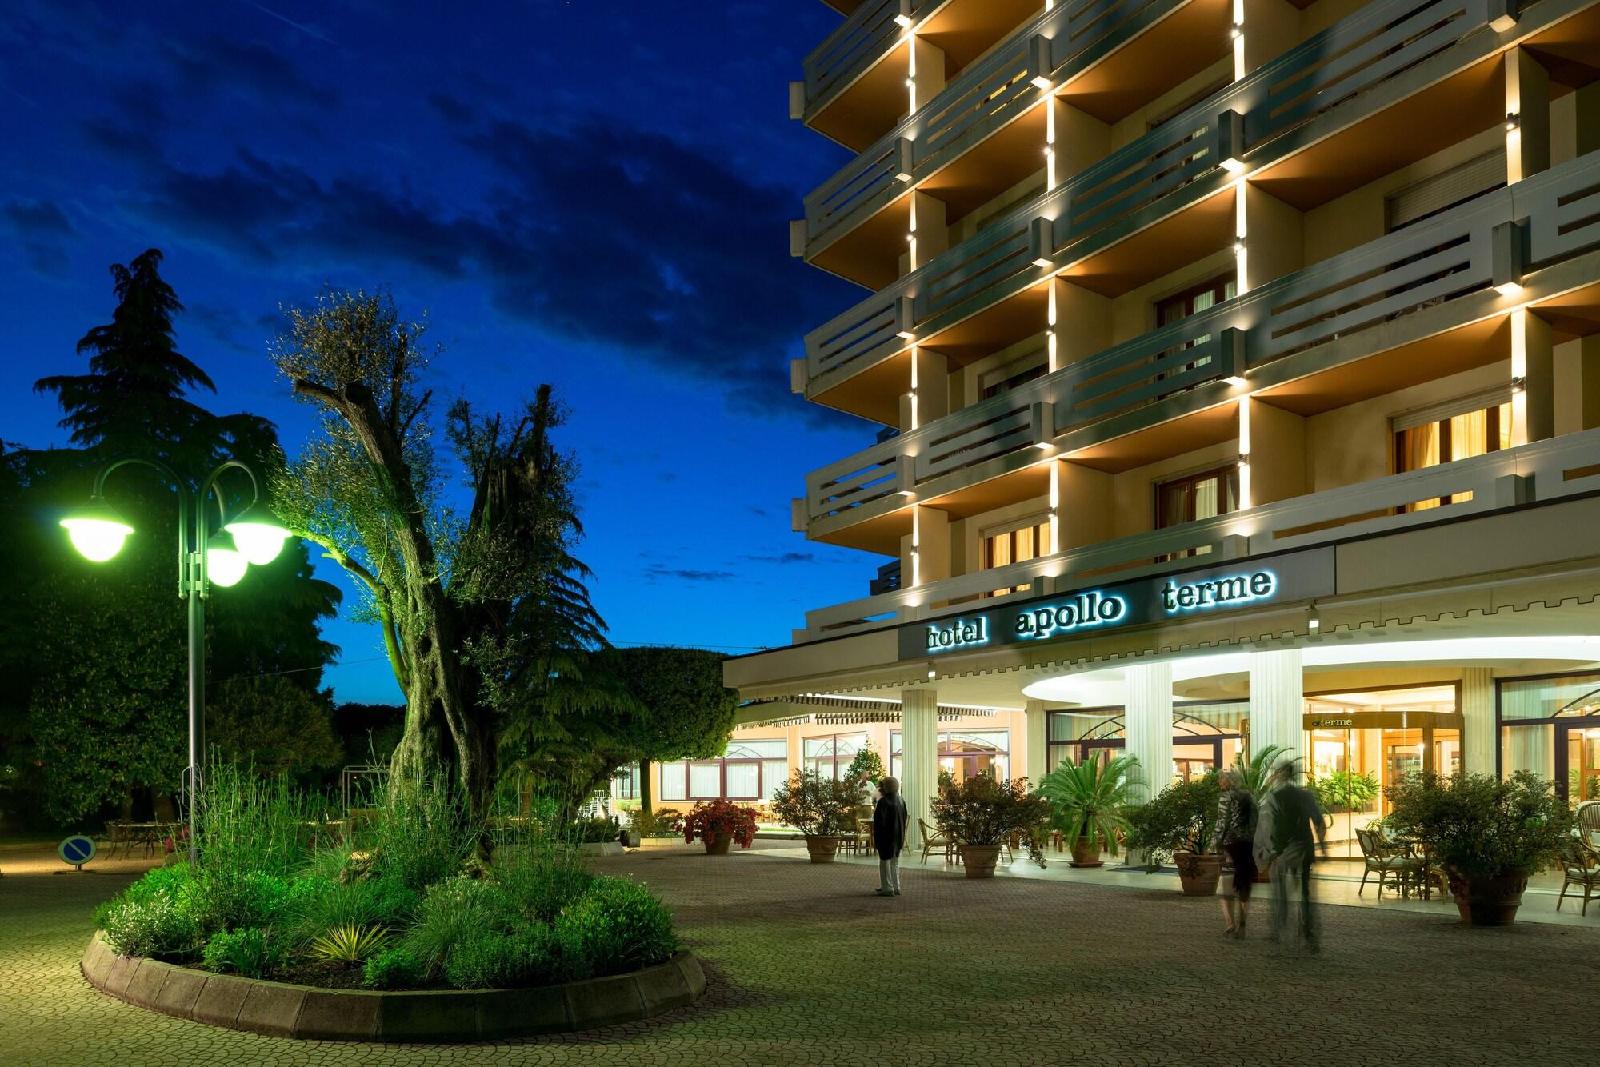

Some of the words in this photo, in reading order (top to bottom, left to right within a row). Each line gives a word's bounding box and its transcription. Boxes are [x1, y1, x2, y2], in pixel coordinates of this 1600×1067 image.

[925, 617, 986, 649] hotel
[1014, 593, 1125, 638] apollo
[1160, 571, 1276, 611] terme
